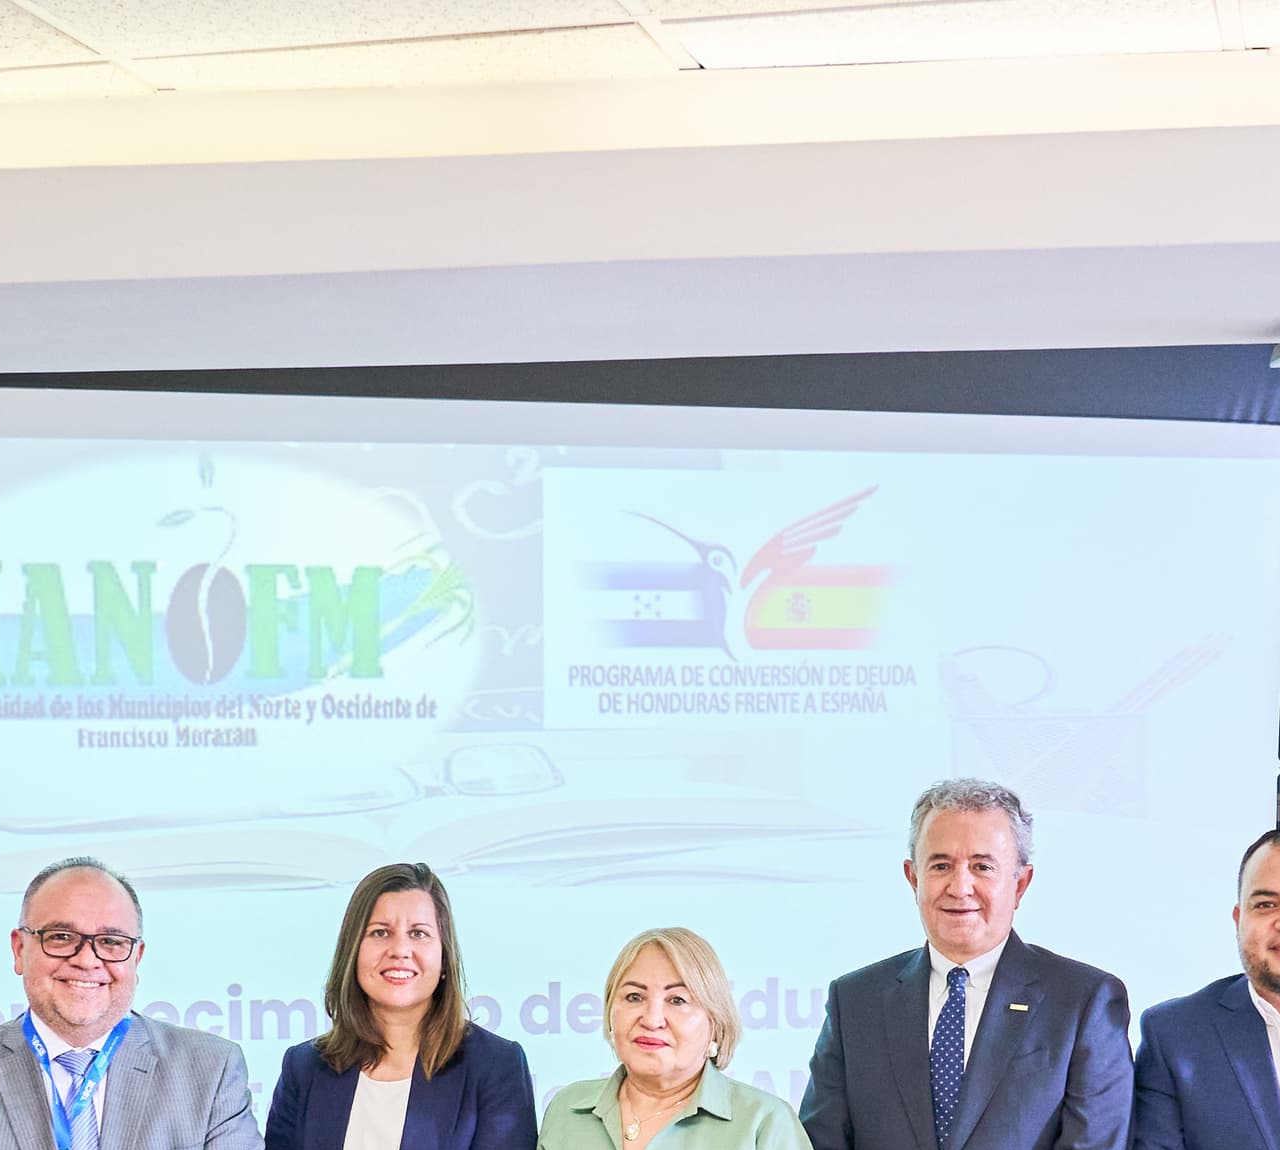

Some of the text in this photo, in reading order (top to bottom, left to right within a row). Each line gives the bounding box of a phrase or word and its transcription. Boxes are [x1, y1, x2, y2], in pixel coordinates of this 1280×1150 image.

[568, 660, 917, 687] PROGRAMA DE CONVERSIÓN DE DEUDA
[50, 693, 72, 719] de
[76, 693, 104, 719] los
[108, 693, 211, 723] Municipios
[216, 694, 243, 719] del
[248, 693, 301, 719] Norte
[306, 699, 317, 725] y
[321, 693, 413, 719] Occidente
[416, 693, 438, 719] de
[598, 687, 888, 713] DE HONDURAS FRENTE A ESPAÑA
[77, 727, 168, 749] Francisco
[519, 981, 604, 1035] de
